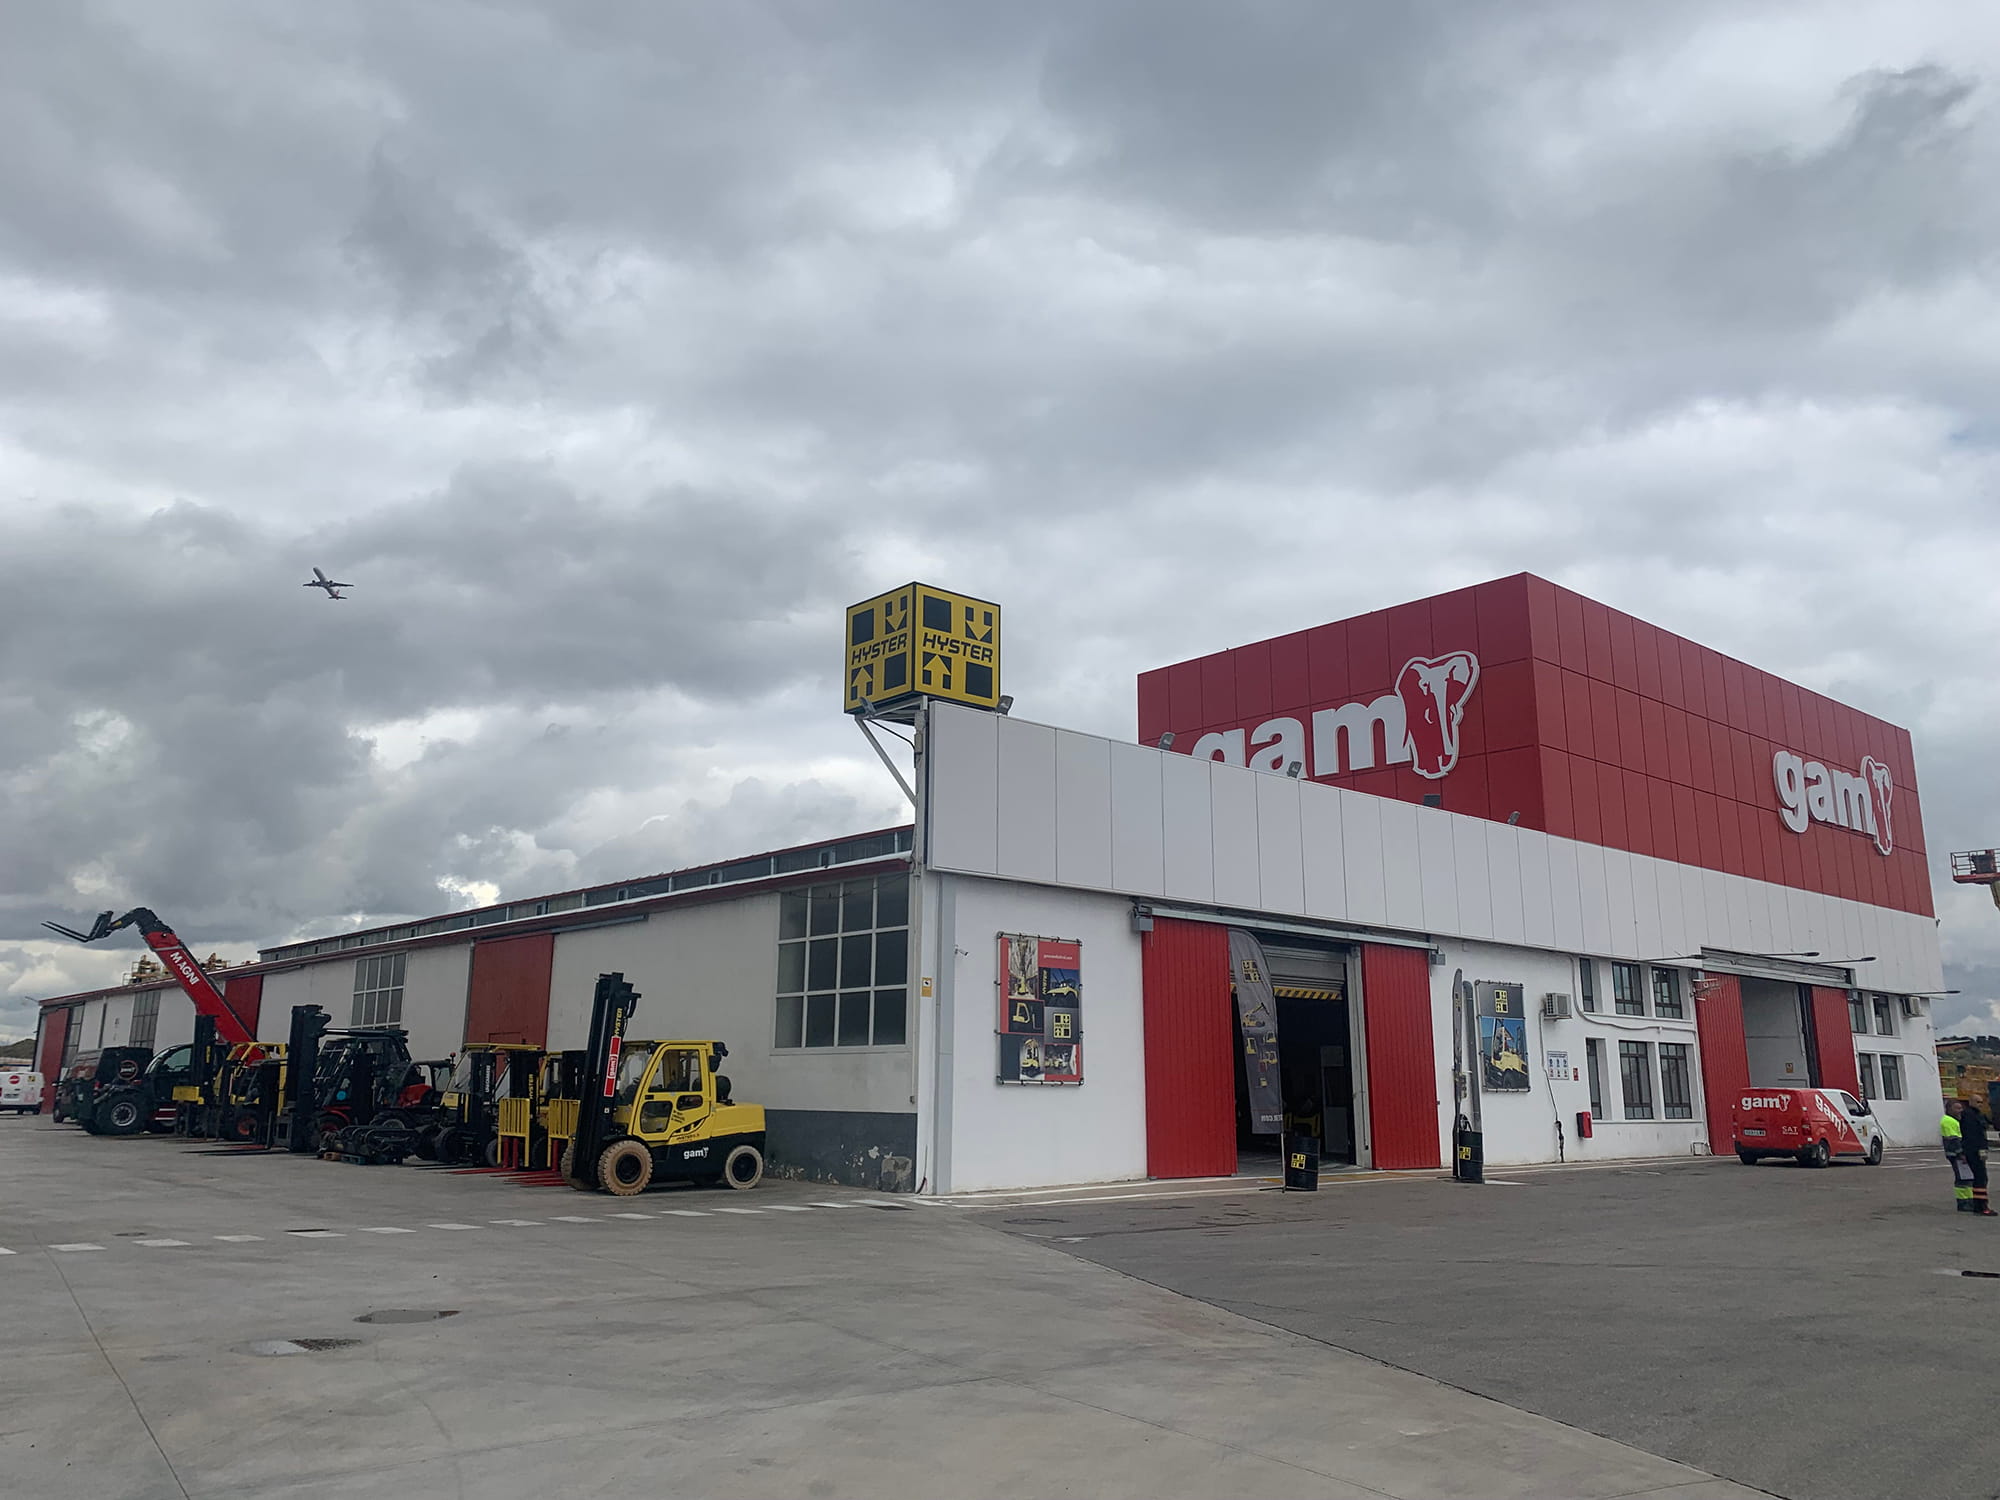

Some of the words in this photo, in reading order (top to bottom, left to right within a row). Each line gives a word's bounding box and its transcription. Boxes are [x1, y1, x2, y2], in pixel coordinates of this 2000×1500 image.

[852, 633, 907, 665] HYSTER
[922, 632, 993, 663] HYSTER
[1773, 750, 1876, 835] gam
[170, 952, 200, 985] MAGNI
[1741, 1096, 1781, 1111] gam
[1814, 1094, 1842, 1132] gam
[683, 1148, 704, 1160] gam
